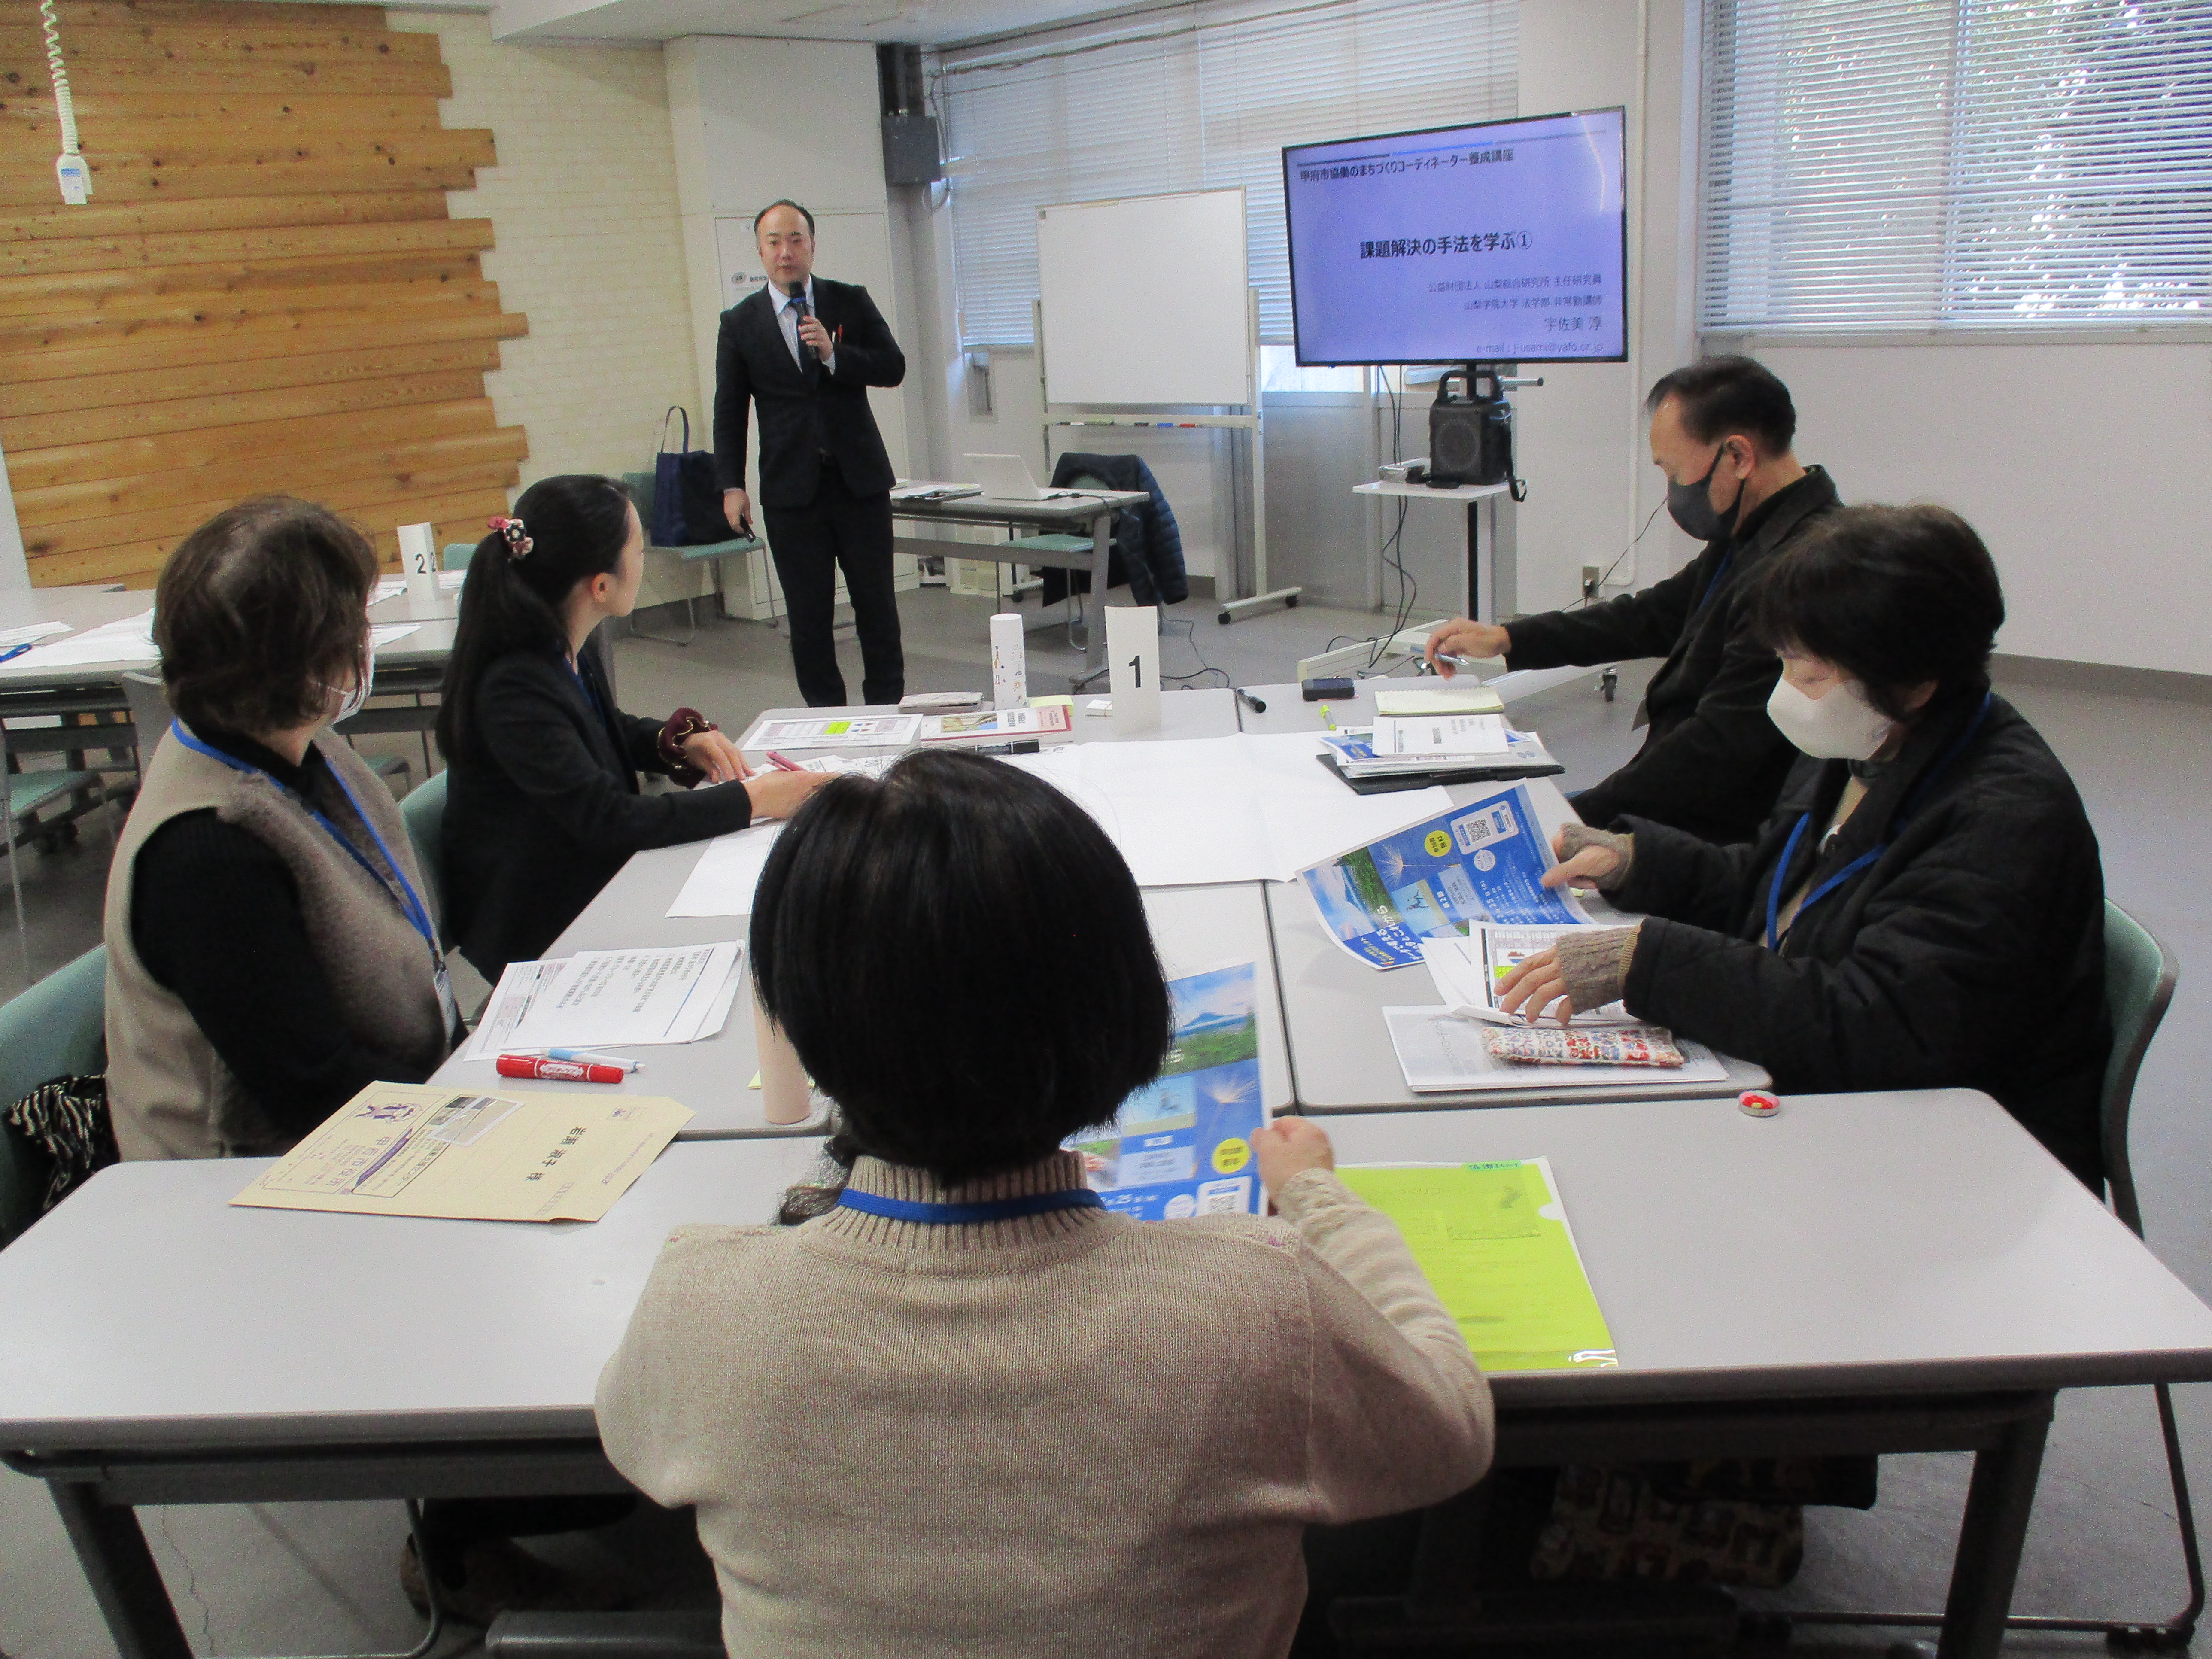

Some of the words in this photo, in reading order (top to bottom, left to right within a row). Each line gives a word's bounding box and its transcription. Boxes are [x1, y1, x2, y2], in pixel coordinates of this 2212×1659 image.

[1300, 149, 1514, 182] 甲府市協働のまちづくりコーディネーター養成講座
[1360, 231, 1532, 260] 課題解決の手法を学ぶ①
[1545, 317, 1583, 331] 宇佐美
[415, 553, 427, 574] 2
[1129, 655, 1141, 688] 1
